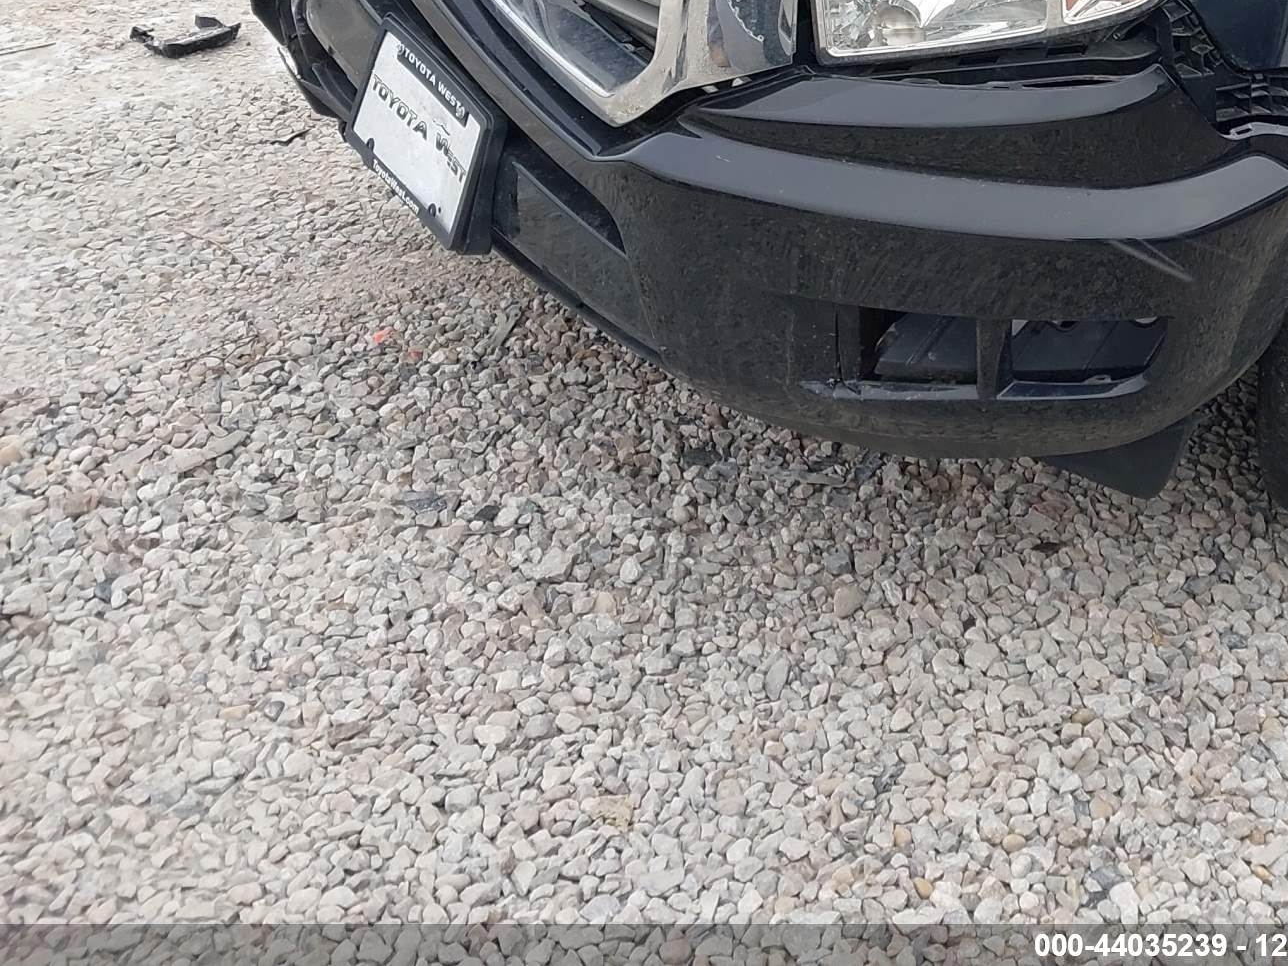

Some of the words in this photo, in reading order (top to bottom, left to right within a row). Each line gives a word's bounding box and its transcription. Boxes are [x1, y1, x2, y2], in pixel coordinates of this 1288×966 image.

[403, 47, 436, 87] TOYOTA
[437, 80, 461, 109] WEST
[371, 73, 428, 141] TOYOTA
[435, 131, 467, 183] WEST
[372, 158, 420, 215] ToyotaWest.com
